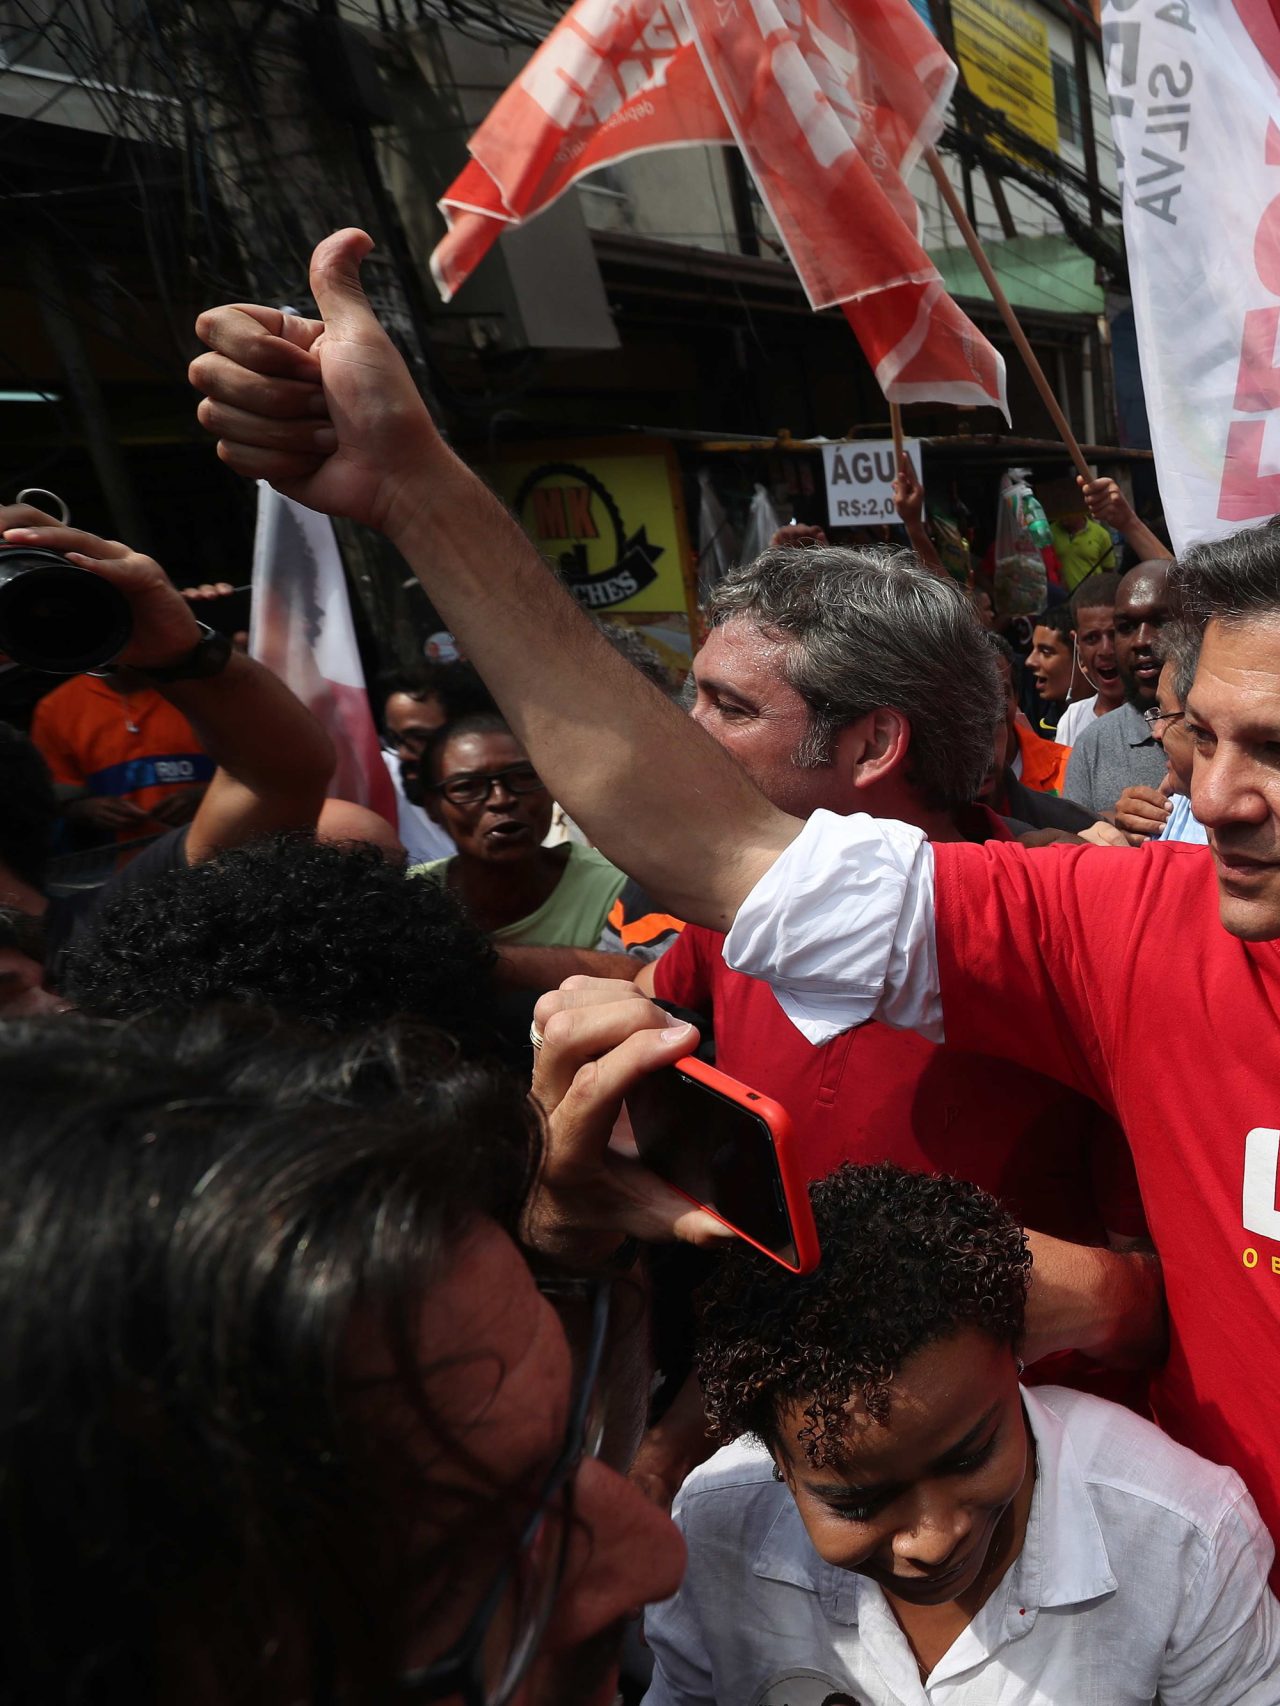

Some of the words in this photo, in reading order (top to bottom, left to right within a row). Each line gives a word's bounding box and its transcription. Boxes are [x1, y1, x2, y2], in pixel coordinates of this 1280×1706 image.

[837, 498, 895, 519] R$:2,0
[573, 570, 638, 605] CHES
[1242, 1247, 1259, 1268] O
